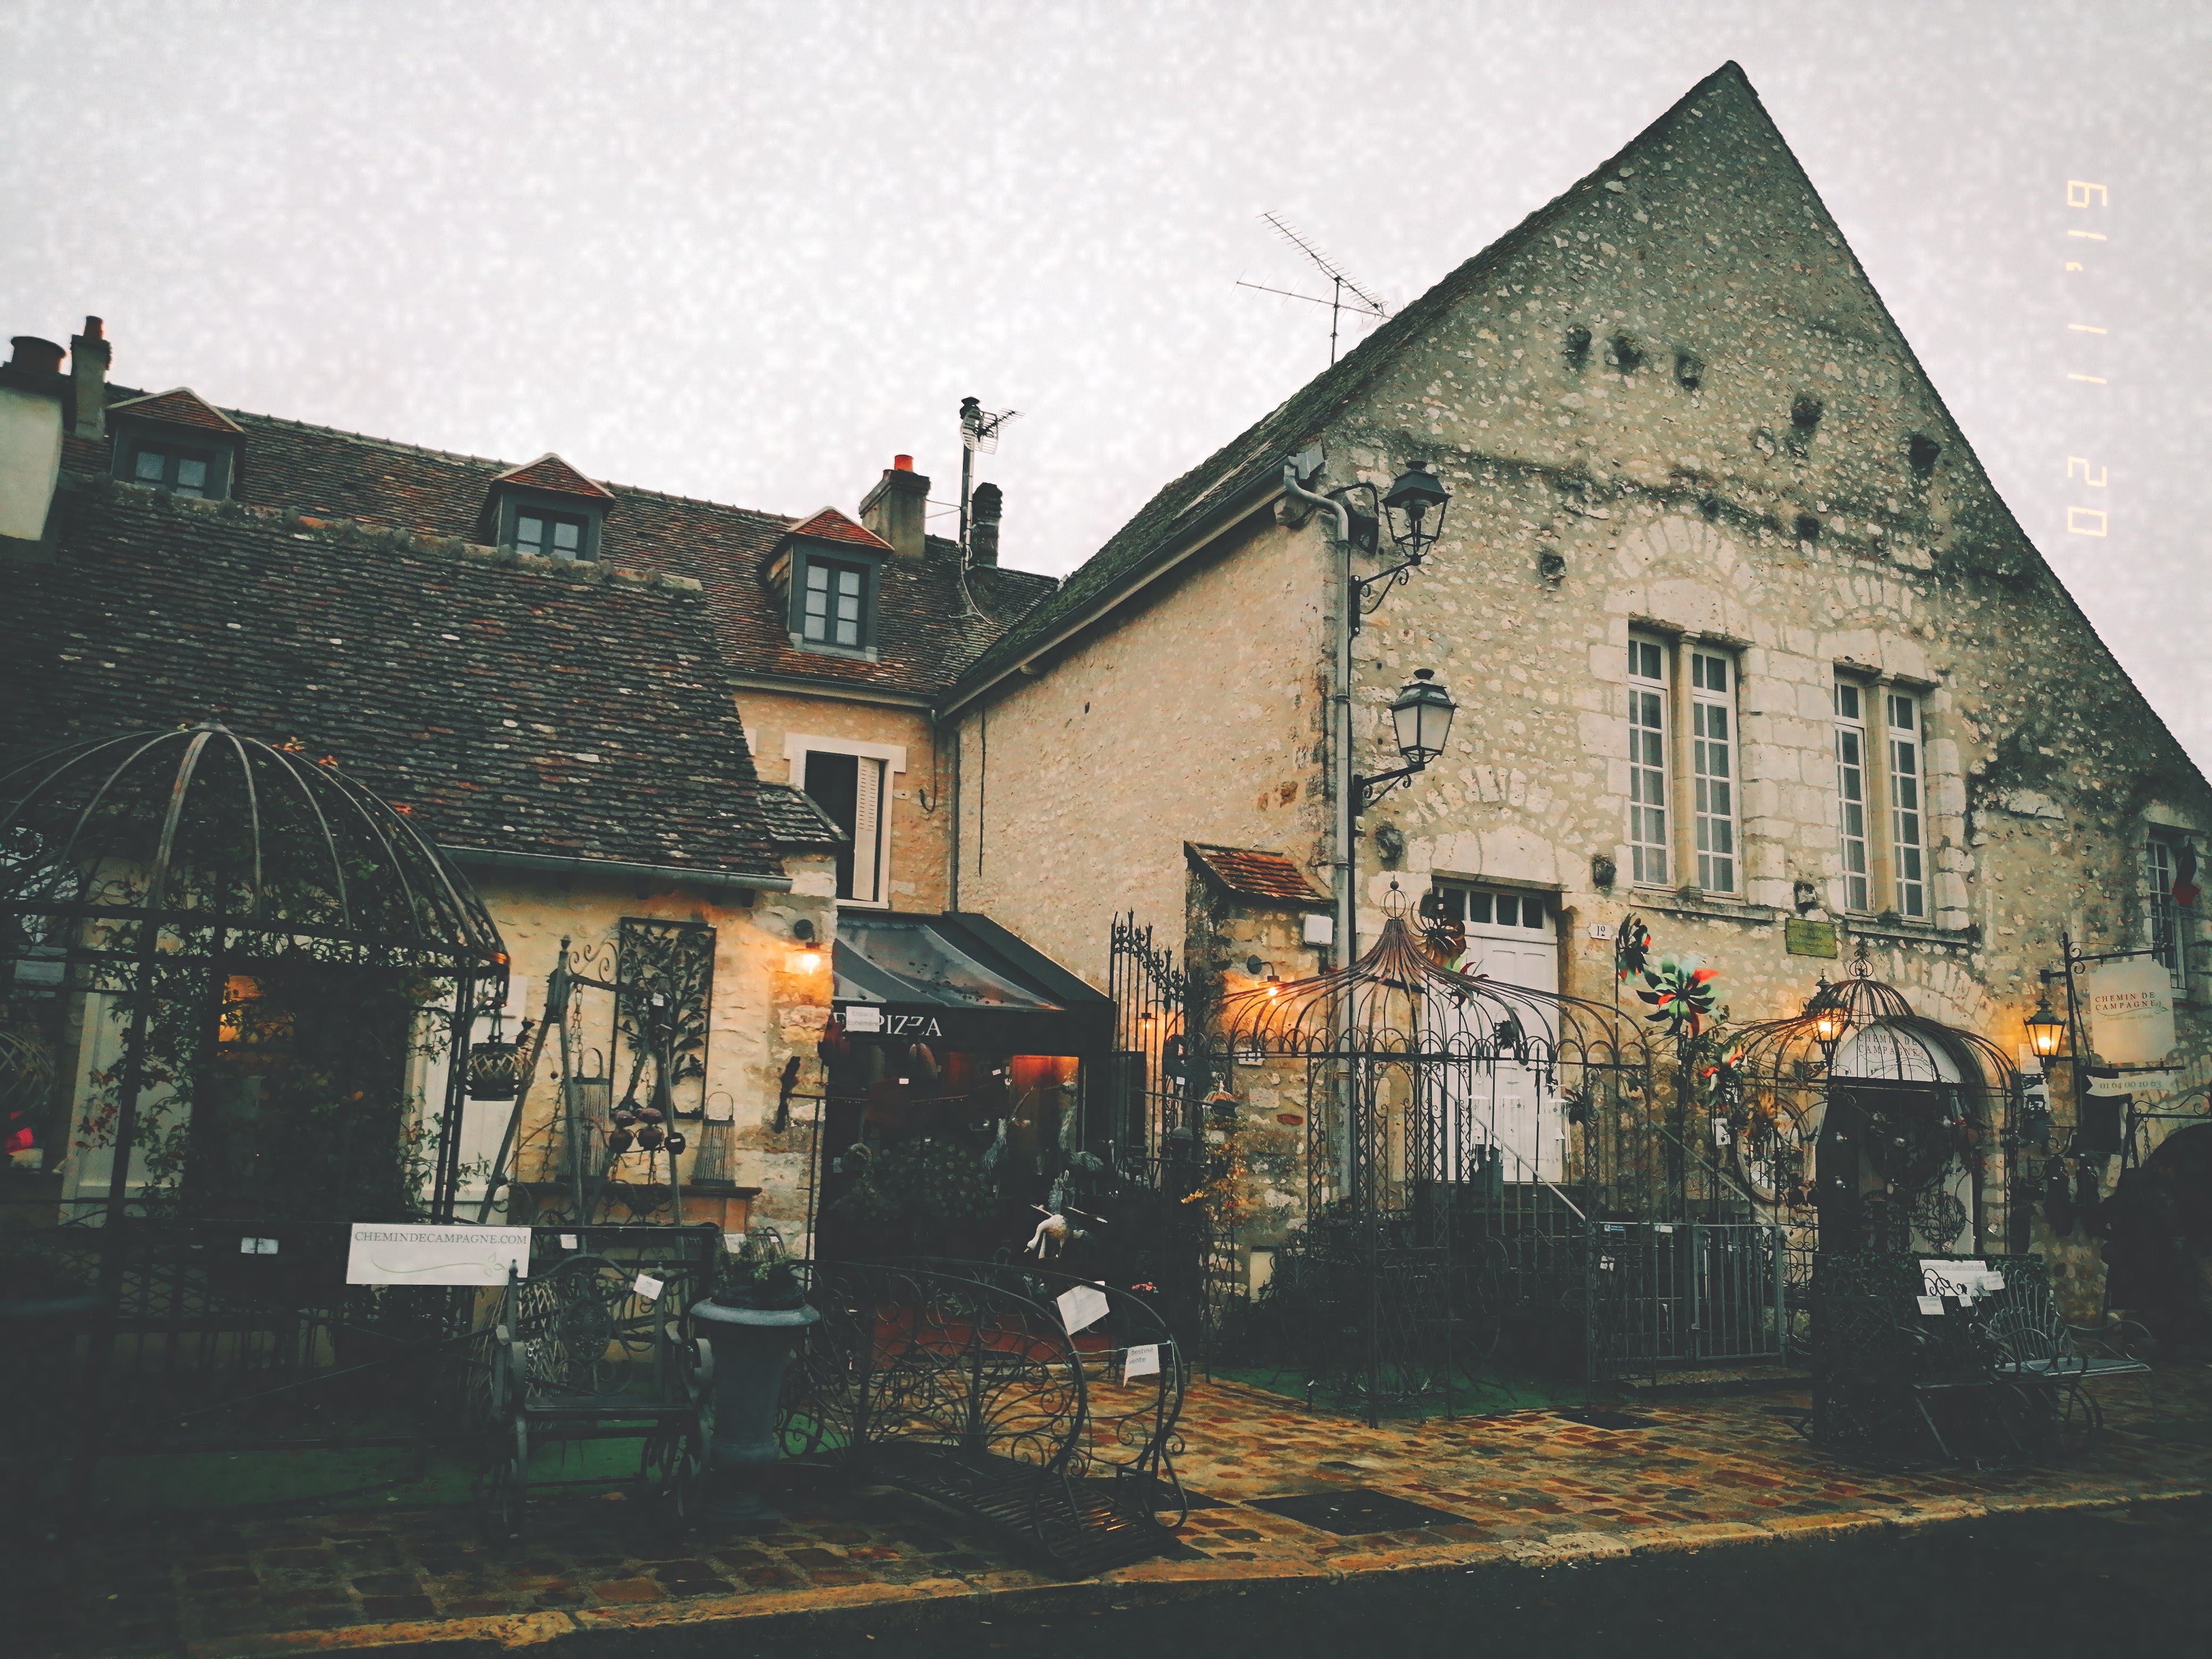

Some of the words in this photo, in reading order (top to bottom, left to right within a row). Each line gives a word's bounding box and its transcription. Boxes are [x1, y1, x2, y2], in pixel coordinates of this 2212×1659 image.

[1596, 925, 1605, 936] 12
[2095, 993, 2136, 1003] CHEMIN
[2095, 1000, 2156, 1011] CAMPAGNE
[1858, 1033, 1899, 1043] CHEMI
[1904, 1036, 1917, 1046] DE
[2112, 1080, 2122, 1090] 64
[2150, 1080, 2162, 1089] 63
[354, 1231, 527, 1245] CHEMINDECAMPAGNE.COM
